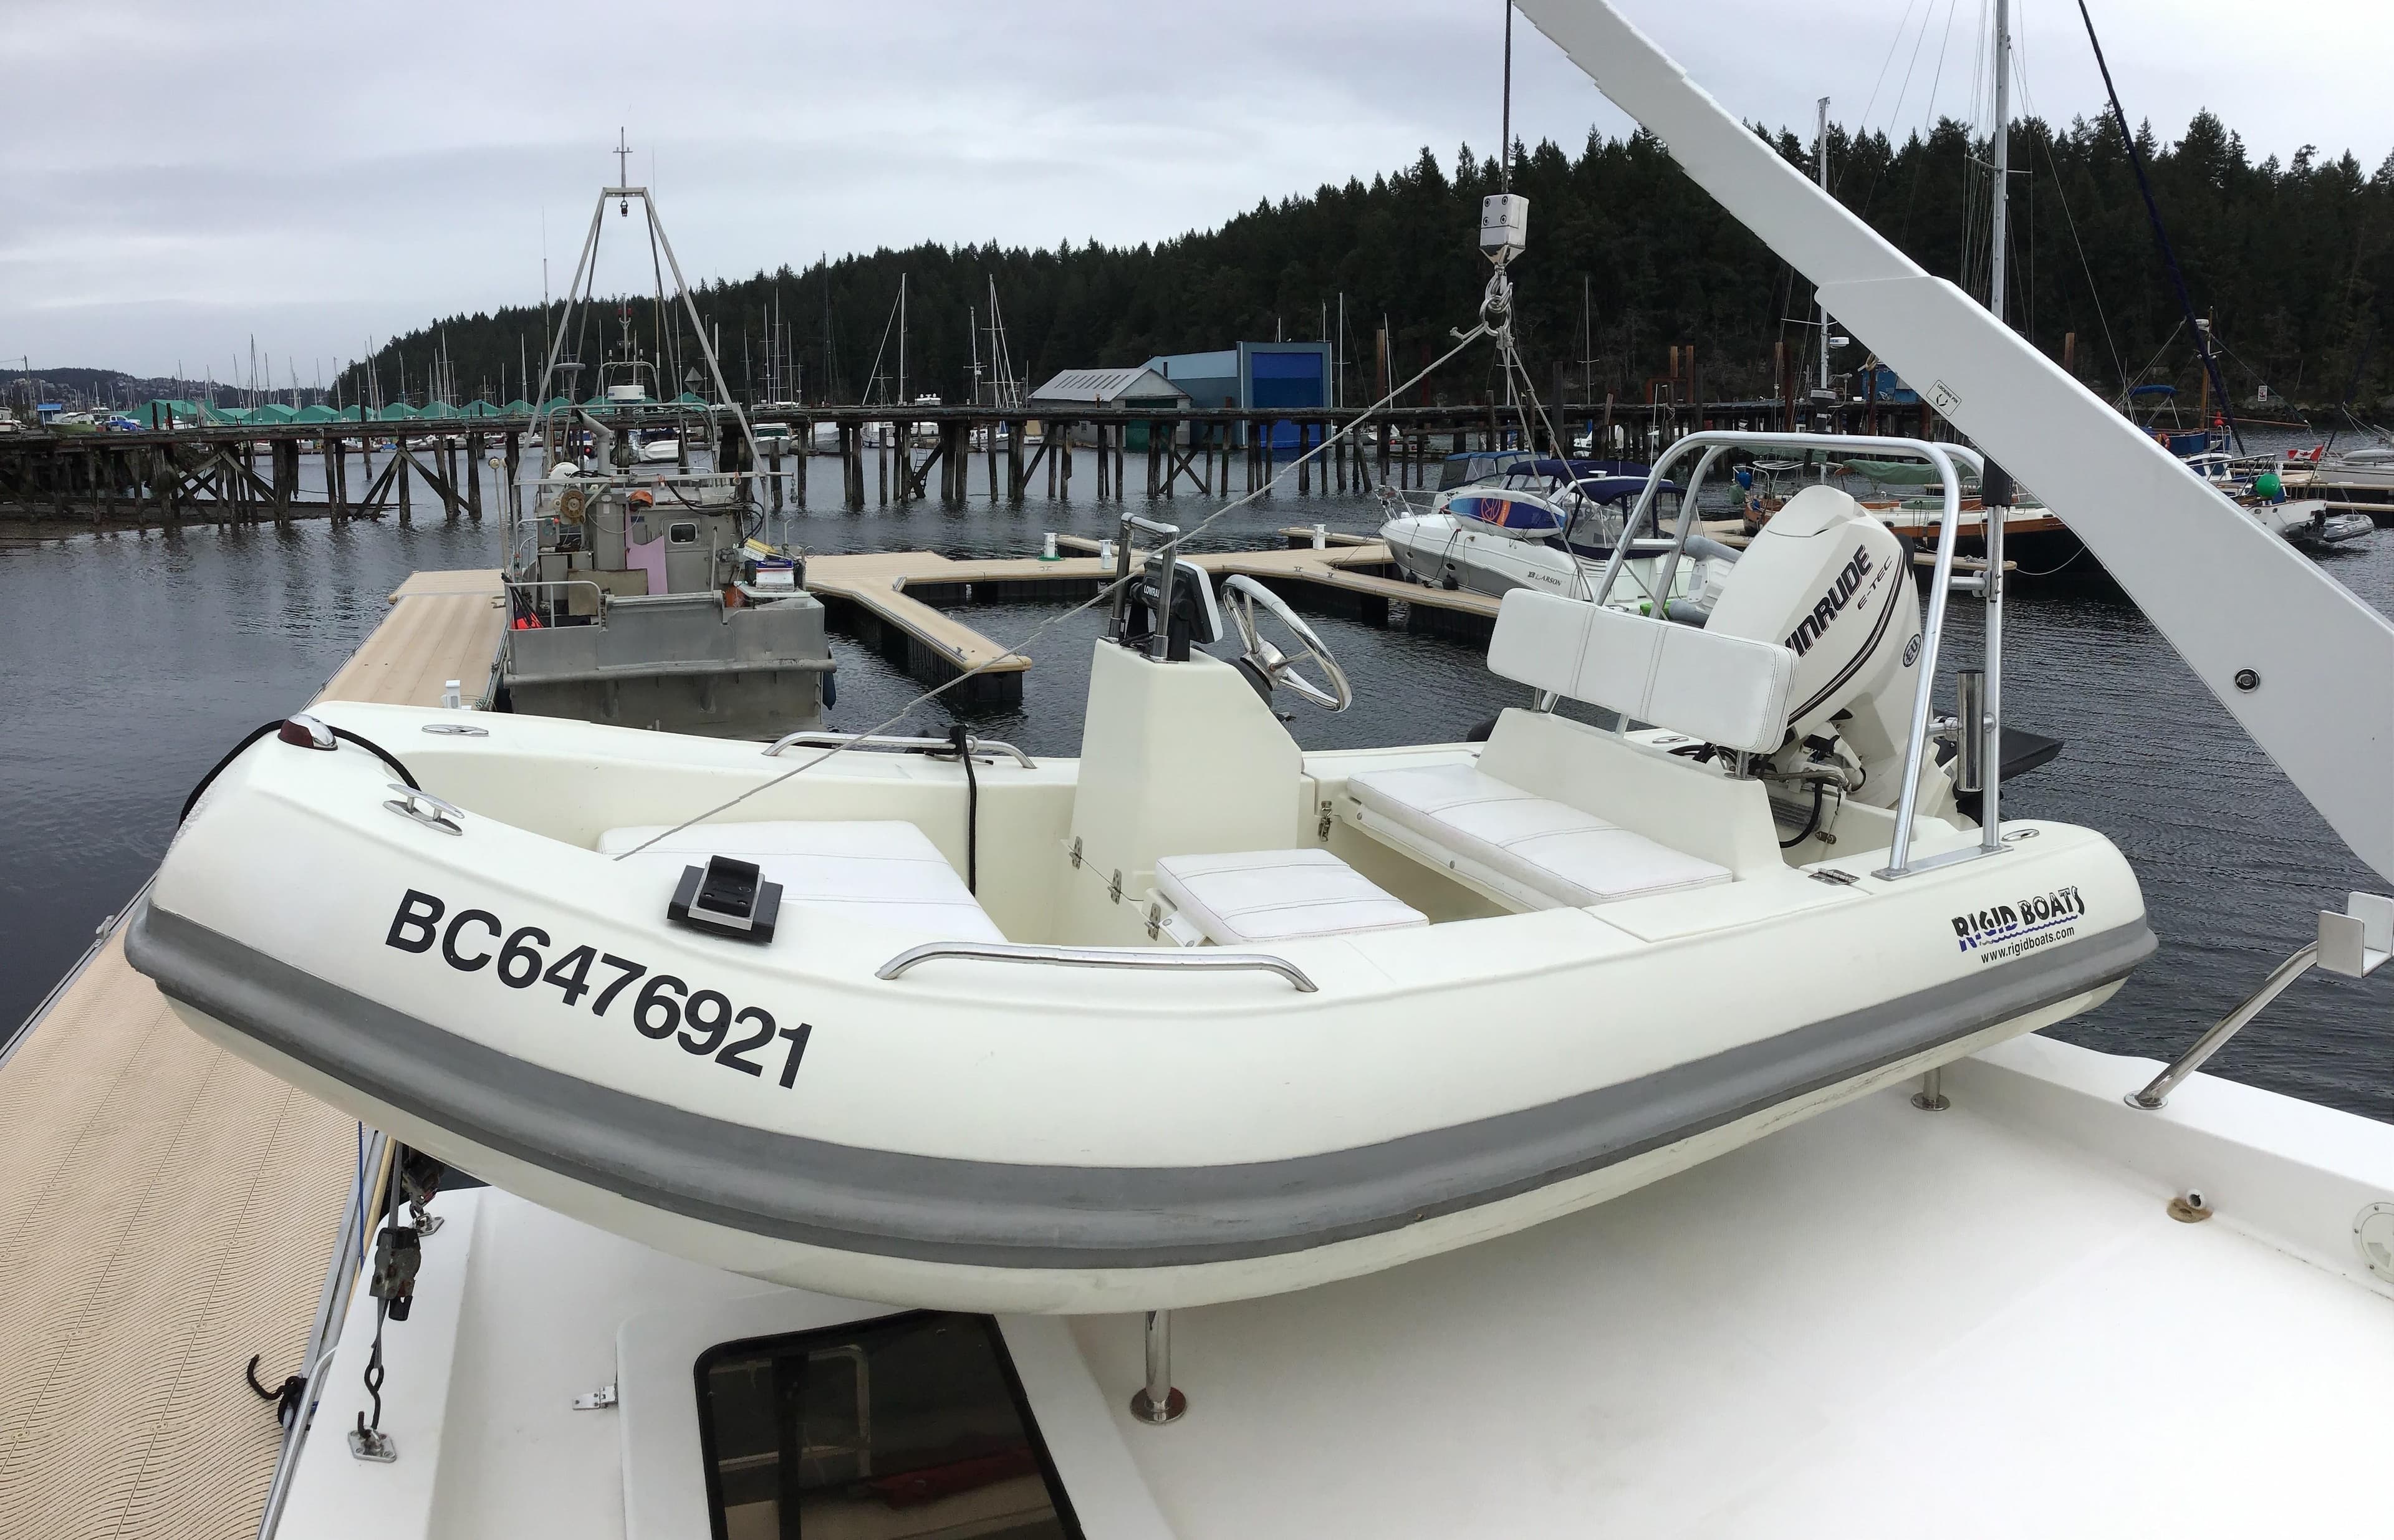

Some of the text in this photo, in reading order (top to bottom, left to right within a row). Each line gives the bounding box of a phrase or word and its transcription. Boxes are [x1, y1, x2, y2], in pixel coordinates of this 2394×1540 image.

[1937, 383, 1952, 398] LOCKING
[1785, 544, 1873, 658] INRUDE
[1857, 556, 1892, 610] E-TEC
[1951, 885, 2085, 953] RIGID BOATS
[1981, 926, 2075, 964] www.rigidboats.com
[385, 888, 812, 1089] BC6476921
